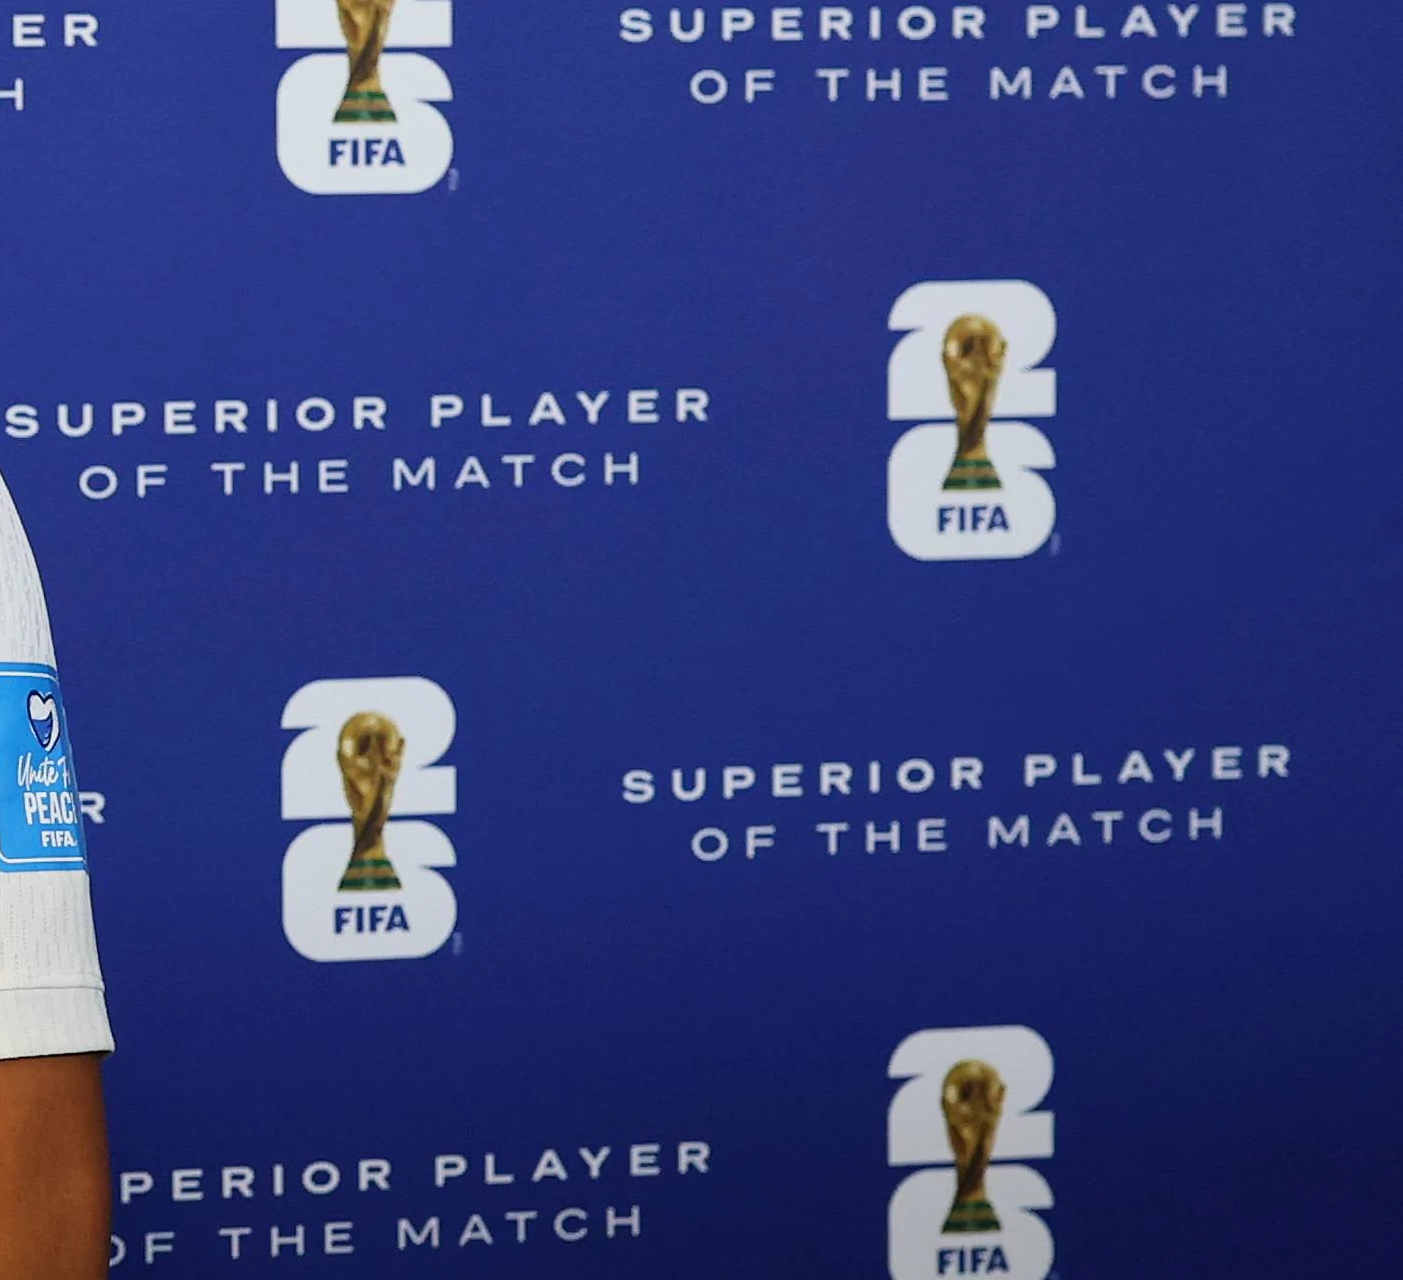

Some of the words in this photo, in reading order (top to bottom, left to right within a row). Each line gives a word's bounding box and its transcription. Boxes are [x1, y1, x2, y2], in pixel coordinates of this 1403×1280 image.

[618, 5, 986, 44] SUPERIOR
[1025, 2, 1296, 39] PLAYER
[689, 68, 776, 105] OF
[815, 66, 949, 103] THE
[989, 64, 1228, 101] MATCH
[328, 137, 406, 168] FIFA
[4, 396, 387, 439] SUPERIOR
[429, 388, 710, 429] PLAYER
[78, 463, 169, 500] OF
[210, 458, 349, 497] THE
[392, 451, 639, 492] MATCH
[17, 752, 59, 791] Unite
[621, 756, 984, 804] SUPERIOR
[1023, 744, 1291, 788] PLAYER
[41, 830, 75, 848] FIFA
[691, 824, 777, 862] OF
[815, 817, 947, 856] THE
[987, 806, 1223, 849] MATCH
[333, 904, 411, 936] FIFA
[120, 1158, 391, 1204] PERIOR
[434, 1141, 710, 1188] PLAYER
[218, 1221, 354, 1260] THE
[397, 1205, 640, 1250] MATCH
